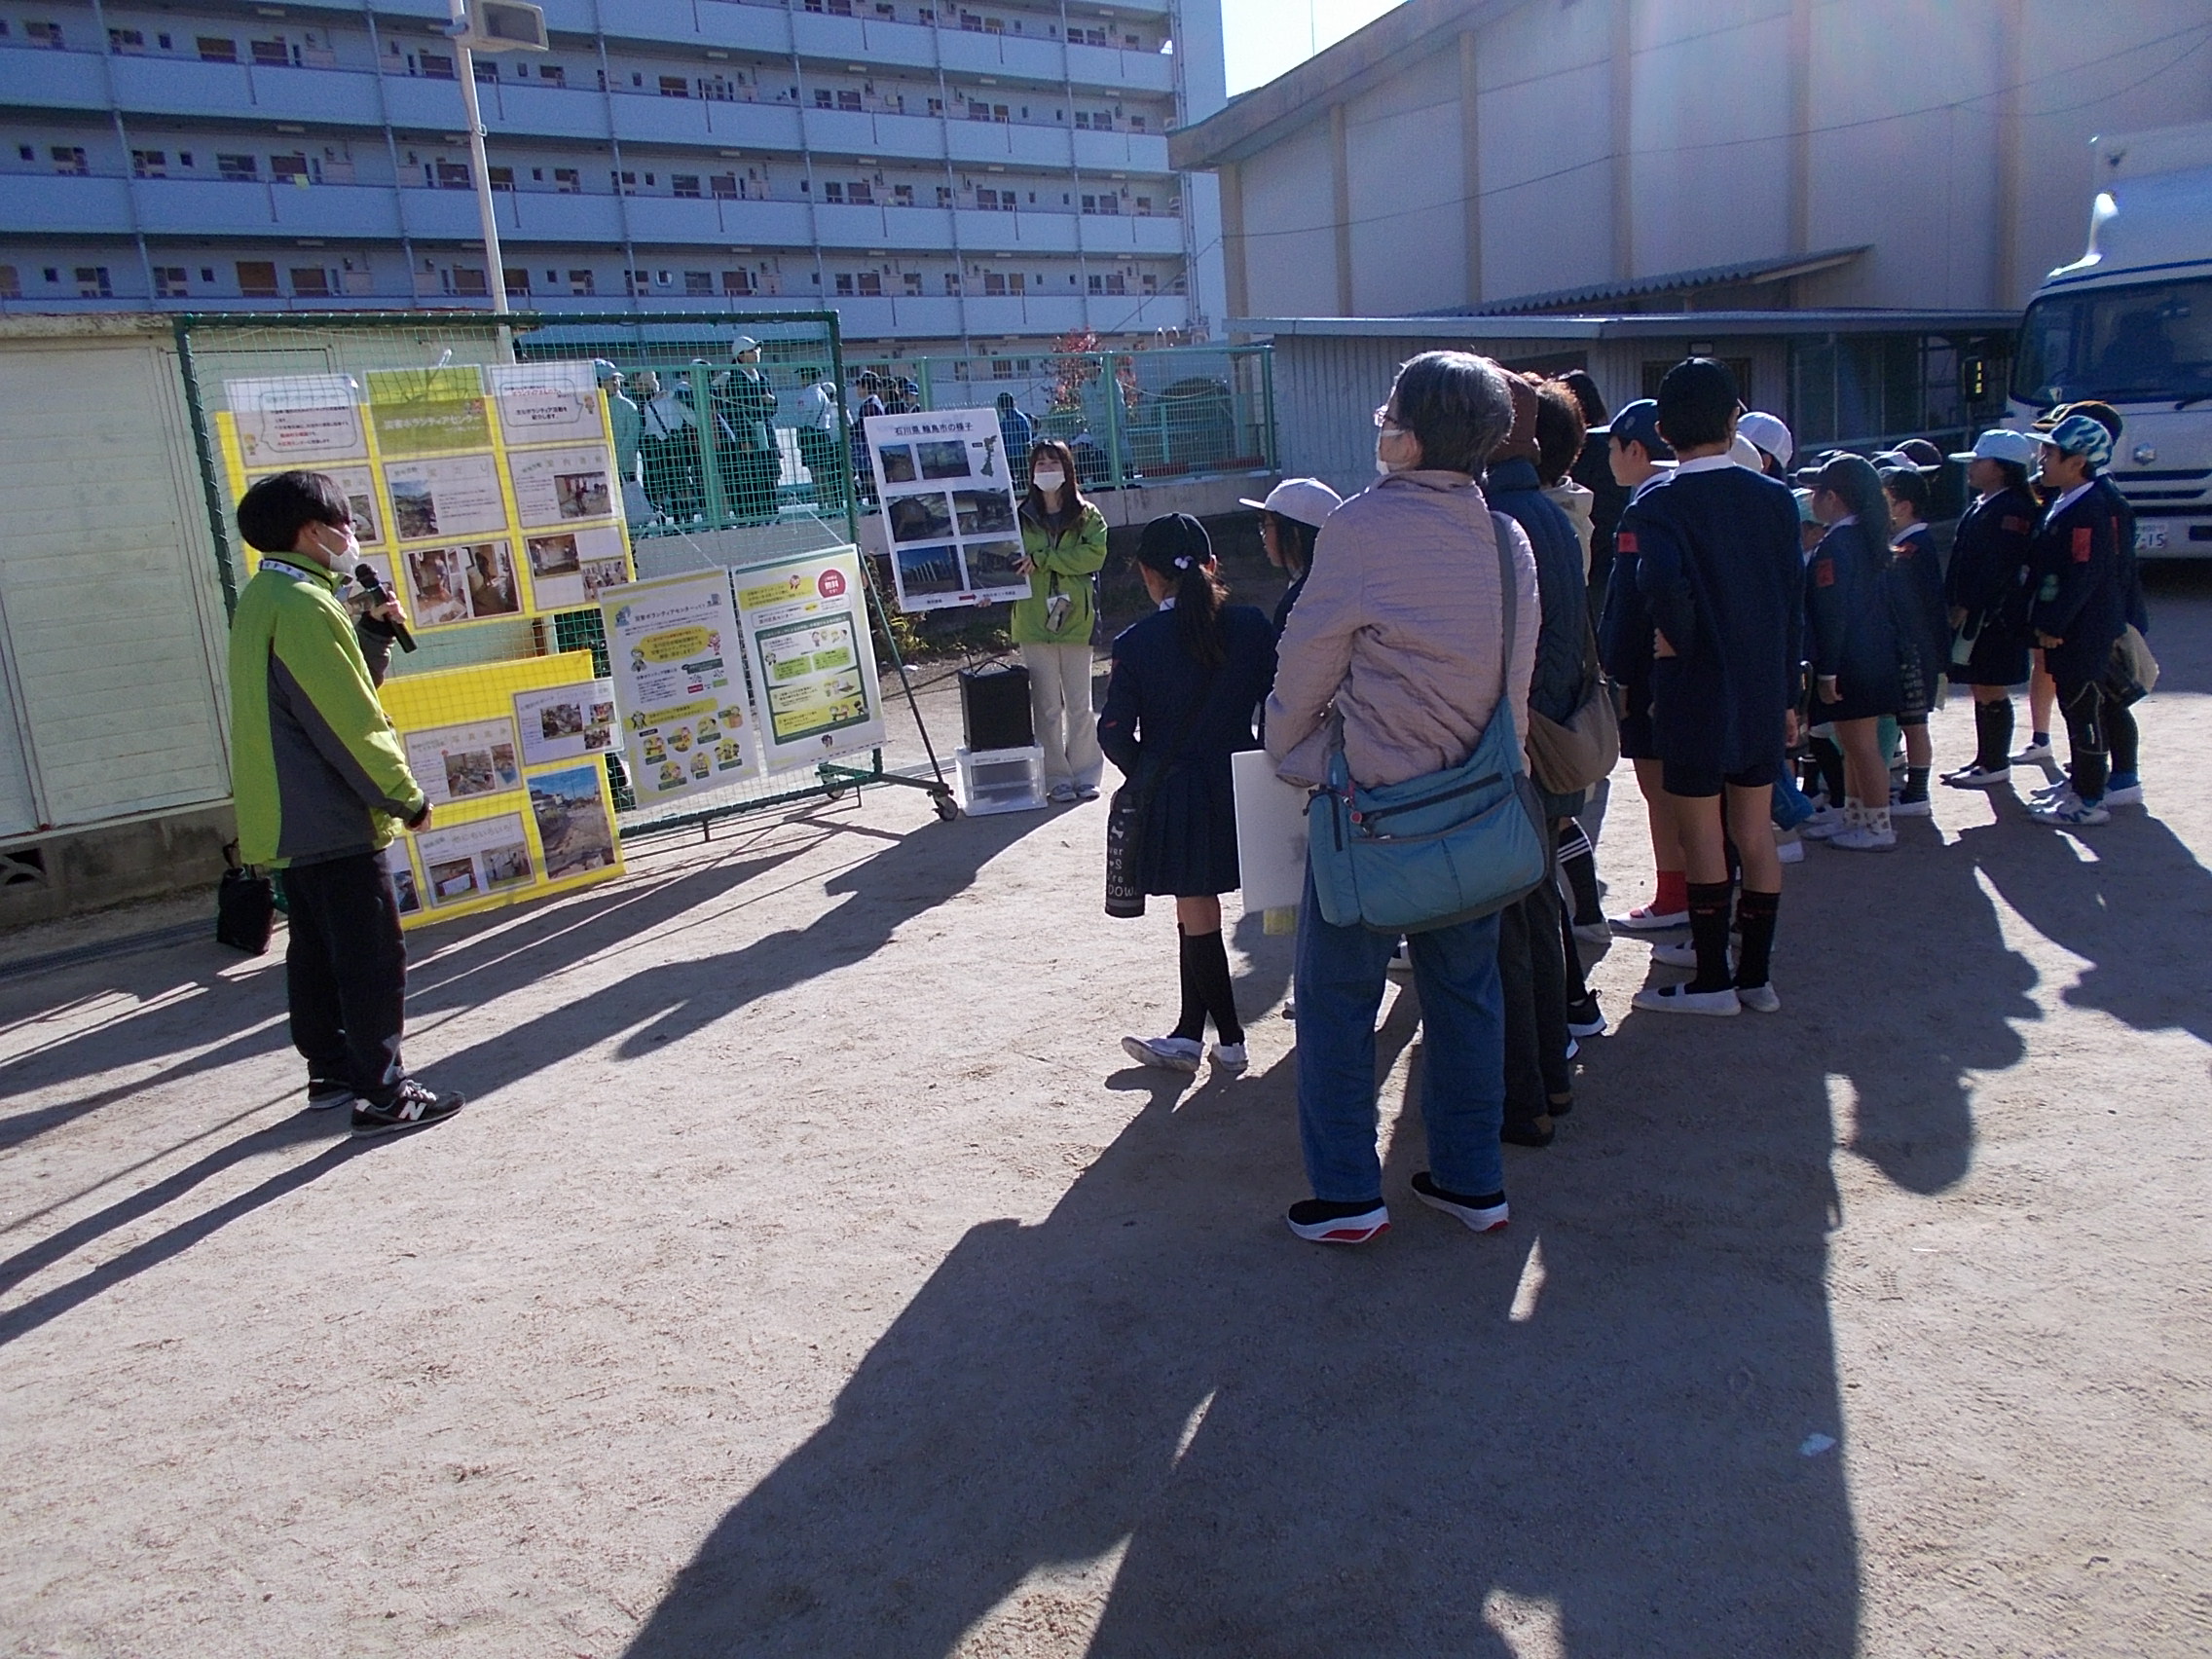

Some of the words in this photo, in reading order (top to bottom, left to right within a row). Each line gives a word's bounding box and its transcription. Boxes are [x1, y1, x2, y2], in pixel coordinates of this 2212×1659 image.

[895, 425, 920, 435] 石川県
[398, 1100, 427, 1121] N
